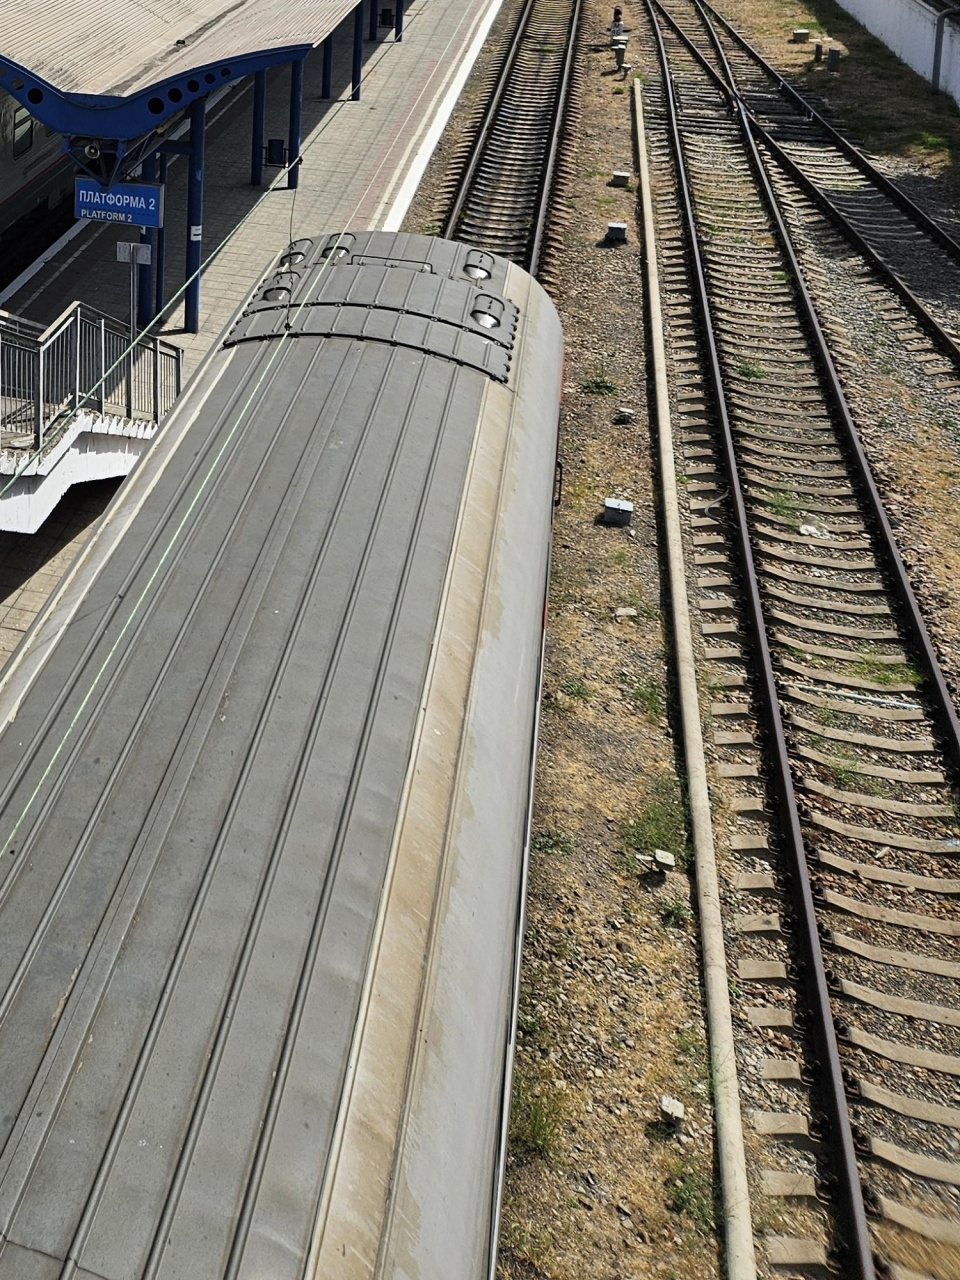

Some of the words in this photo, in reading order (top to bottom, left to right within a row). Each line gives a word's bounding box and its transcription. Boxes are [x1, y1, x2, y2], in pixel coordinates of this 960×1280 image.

[79, 190, 146, 209] ПЛАТФОРМА
[148, 198, 156, 210] 2
[81, 209, 126, 221] PLATFORM
[127, 214, 133, 222] 2
